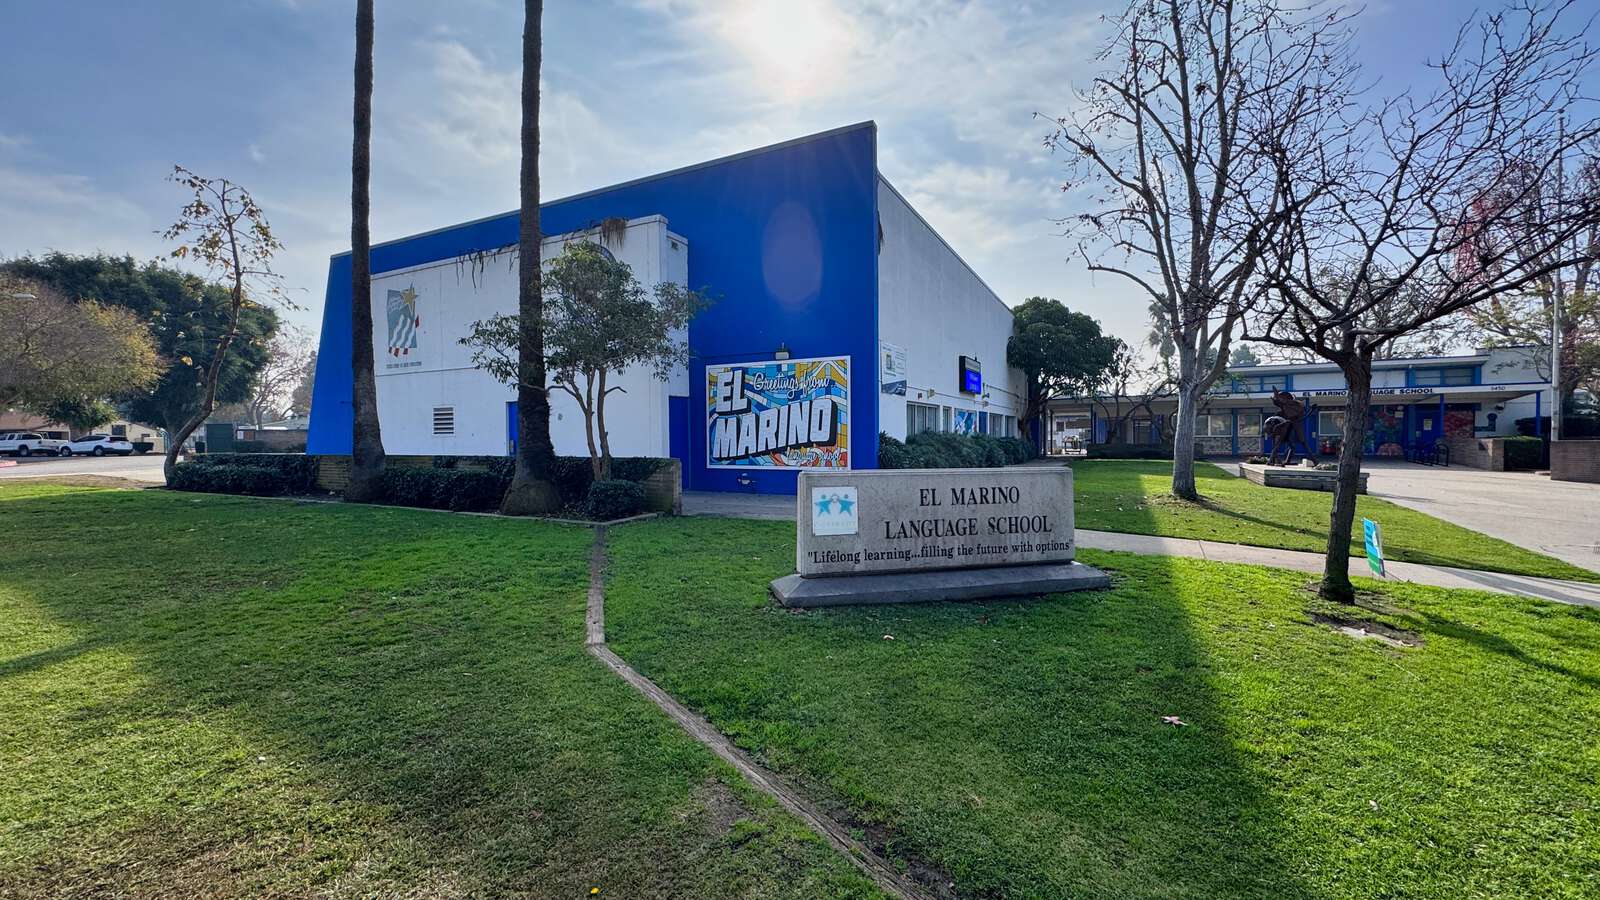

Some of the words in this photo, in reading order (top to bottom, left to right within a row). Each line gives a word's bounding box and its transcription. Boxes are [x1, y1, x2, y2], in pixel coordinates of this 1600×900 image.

[715, 369, 748, 412] EL
[753, 372, 799, 399] Greetings
[712, 399, 833, 458] MARINO
[919, 488, 941, 506] EL
[951, 486, 1020, 507] MARINO
[884, 518, 978, 539] LANGUAGE
[988, 515, 1052, 536] SCHOOL
[808, 550, 861, 564] "Lifelong
[957, 544, 974, 556] the
[977, 543, 1009, 555] future
[1011, 541, 1033, 553] with
